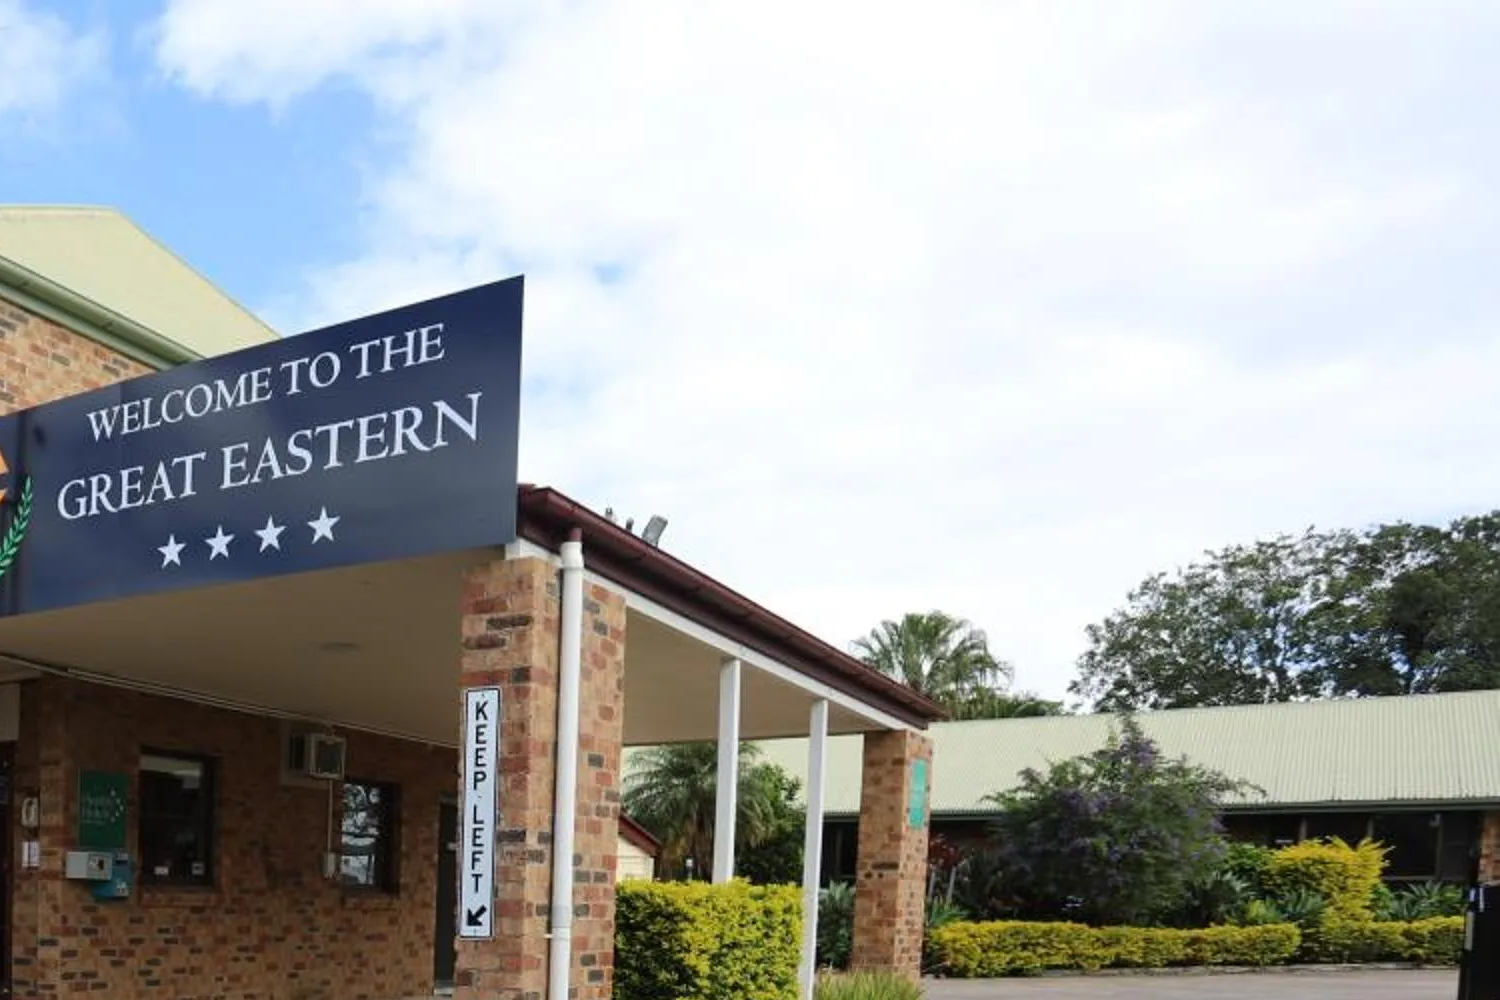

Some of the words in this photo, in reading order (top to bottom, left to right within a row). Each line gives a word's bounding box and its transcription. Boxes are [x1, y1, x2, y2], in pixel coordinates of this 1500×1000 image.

[88, 367, 273, 442] WELCOME
[279, 352, 340, 395] TO
[349, 323, 446, 376] THE
[57, 453, 207, 520] GREAT
[221, 393, 483, 487] EASTERN
[474, 702, 488, 790] KEEP
[471, 805, 485, 893] LEFT
